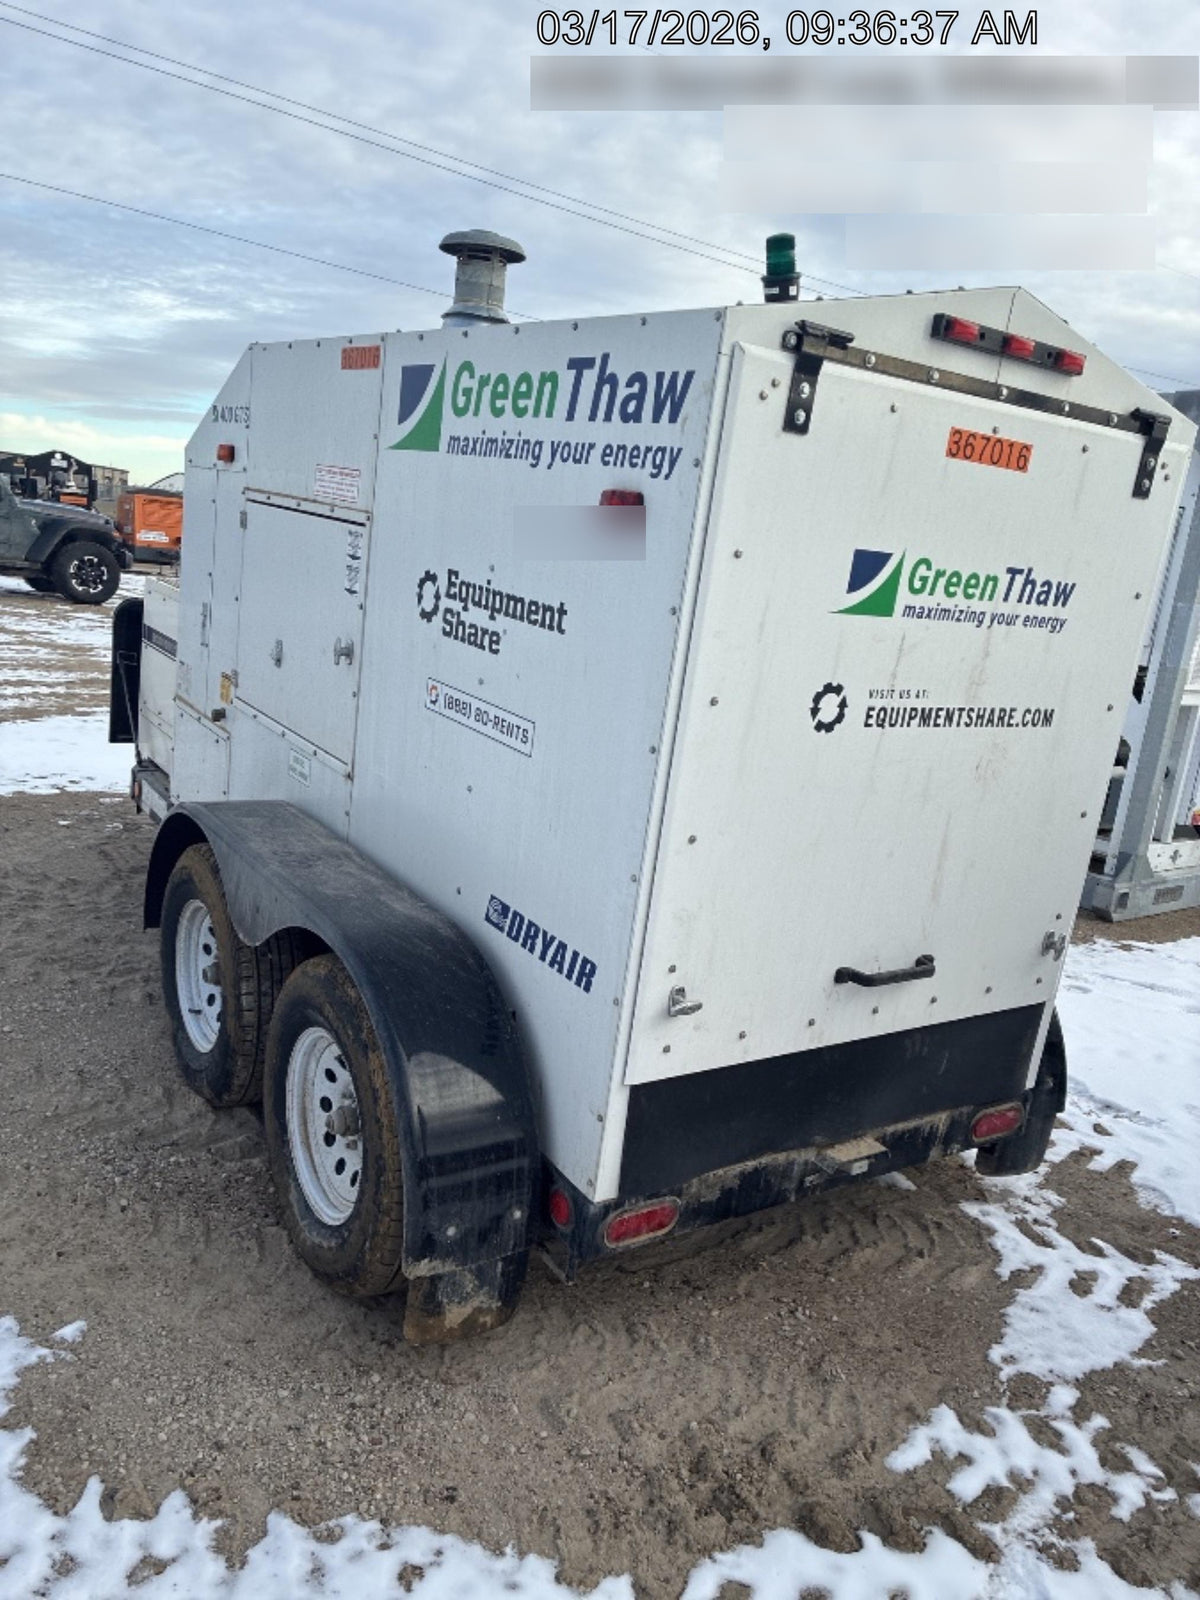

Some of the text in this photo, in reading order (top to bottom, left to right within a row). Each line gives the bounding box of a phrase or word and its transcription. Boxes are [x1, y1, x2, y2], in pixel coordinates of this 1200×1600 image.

[447, 430, 683, 480] maximizing your energy
[949, 429, 1029, 470] 367016
[445, 568, 568, 635] Equipment
[902, 602, 1068, 634] maximizing your energy
[442, 607, 501, 655] Share
[868, 689, 896, 699] VISIT
[899, 689, 911, 699] US
[863, 706, 1055, 730] EQUIPMENTSHARE.COM
[506, 909, 597, 994] DRYAIR
